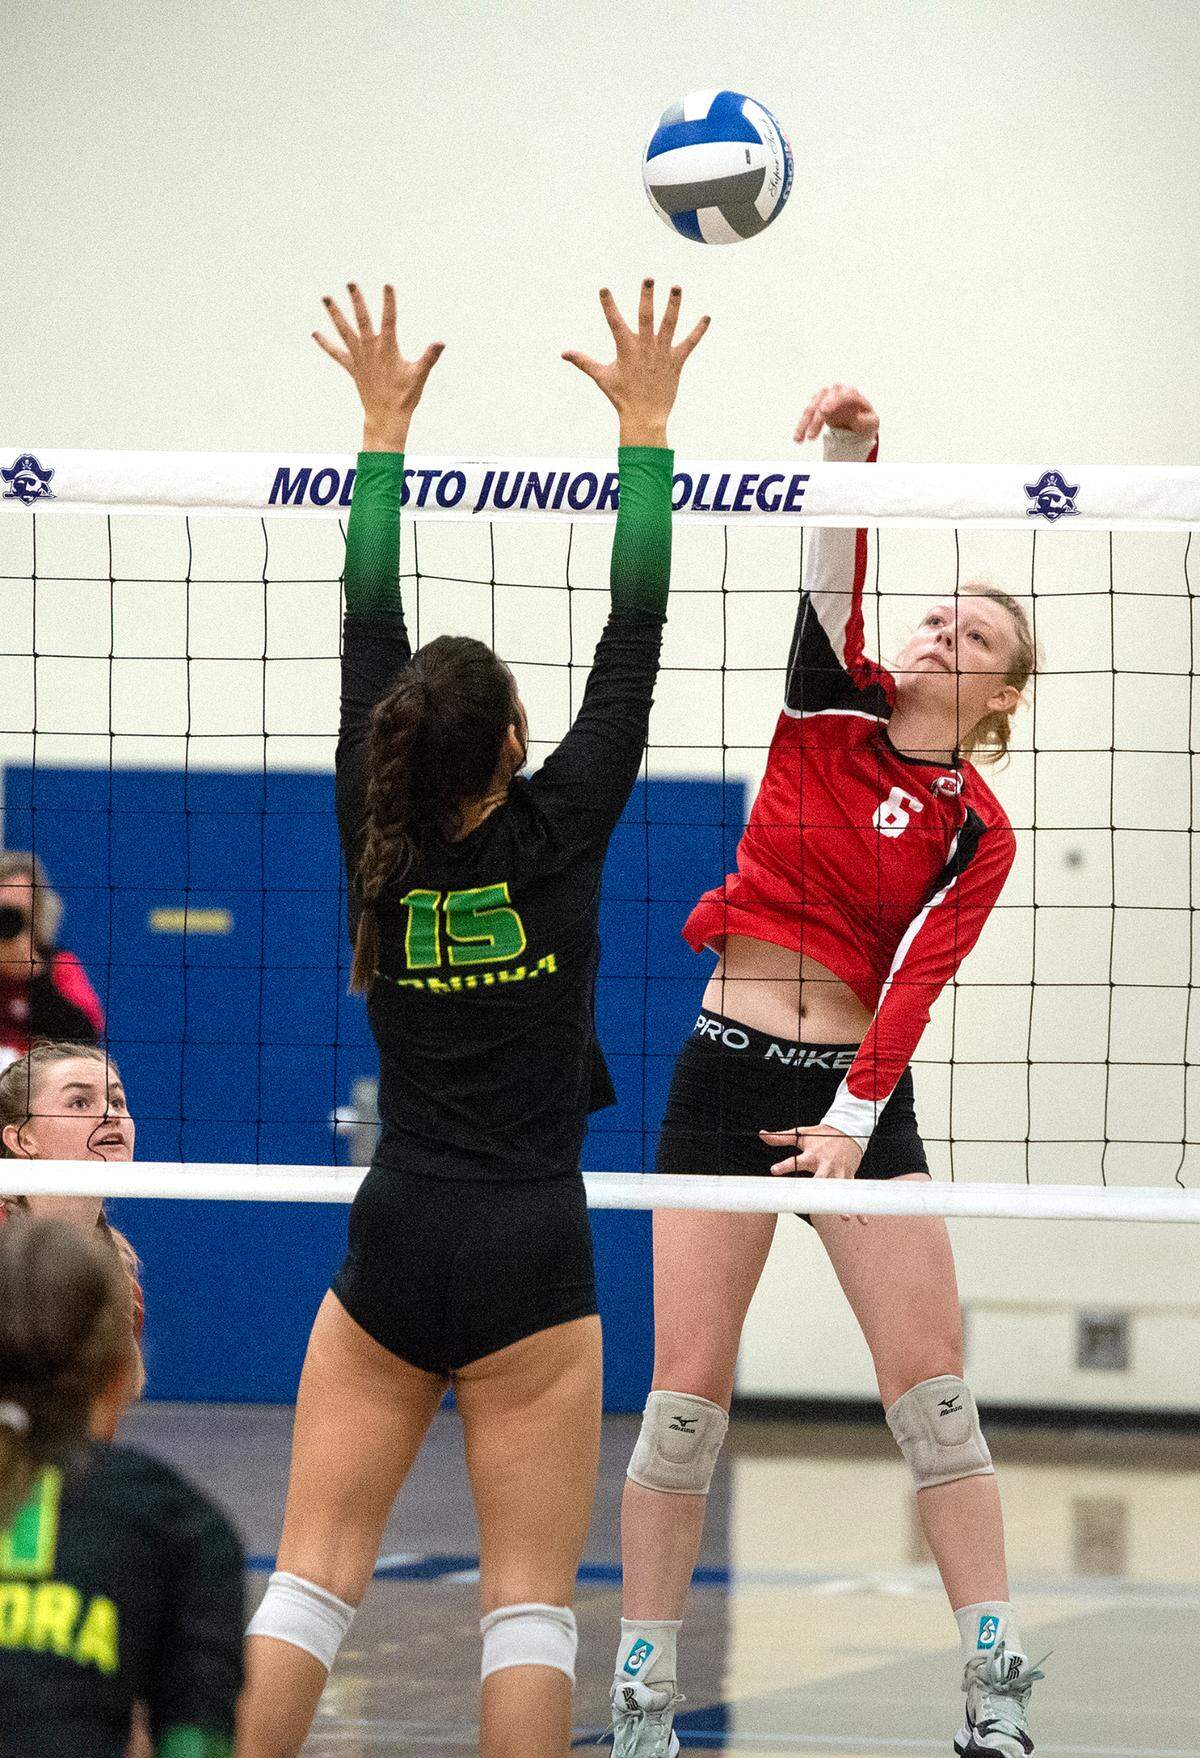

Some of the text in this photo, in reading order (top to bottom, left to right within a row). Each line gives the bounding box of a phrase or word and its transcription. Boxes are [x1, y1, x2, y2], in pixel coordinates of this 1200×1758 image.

[268, 467, 810, 514] MOSTO JUNIOR OLLEGE
[872, 786, 924, 838] 6
[400, 882, 527, 969] 15
[693, 1014, 858, 1070] PRO NIKE
